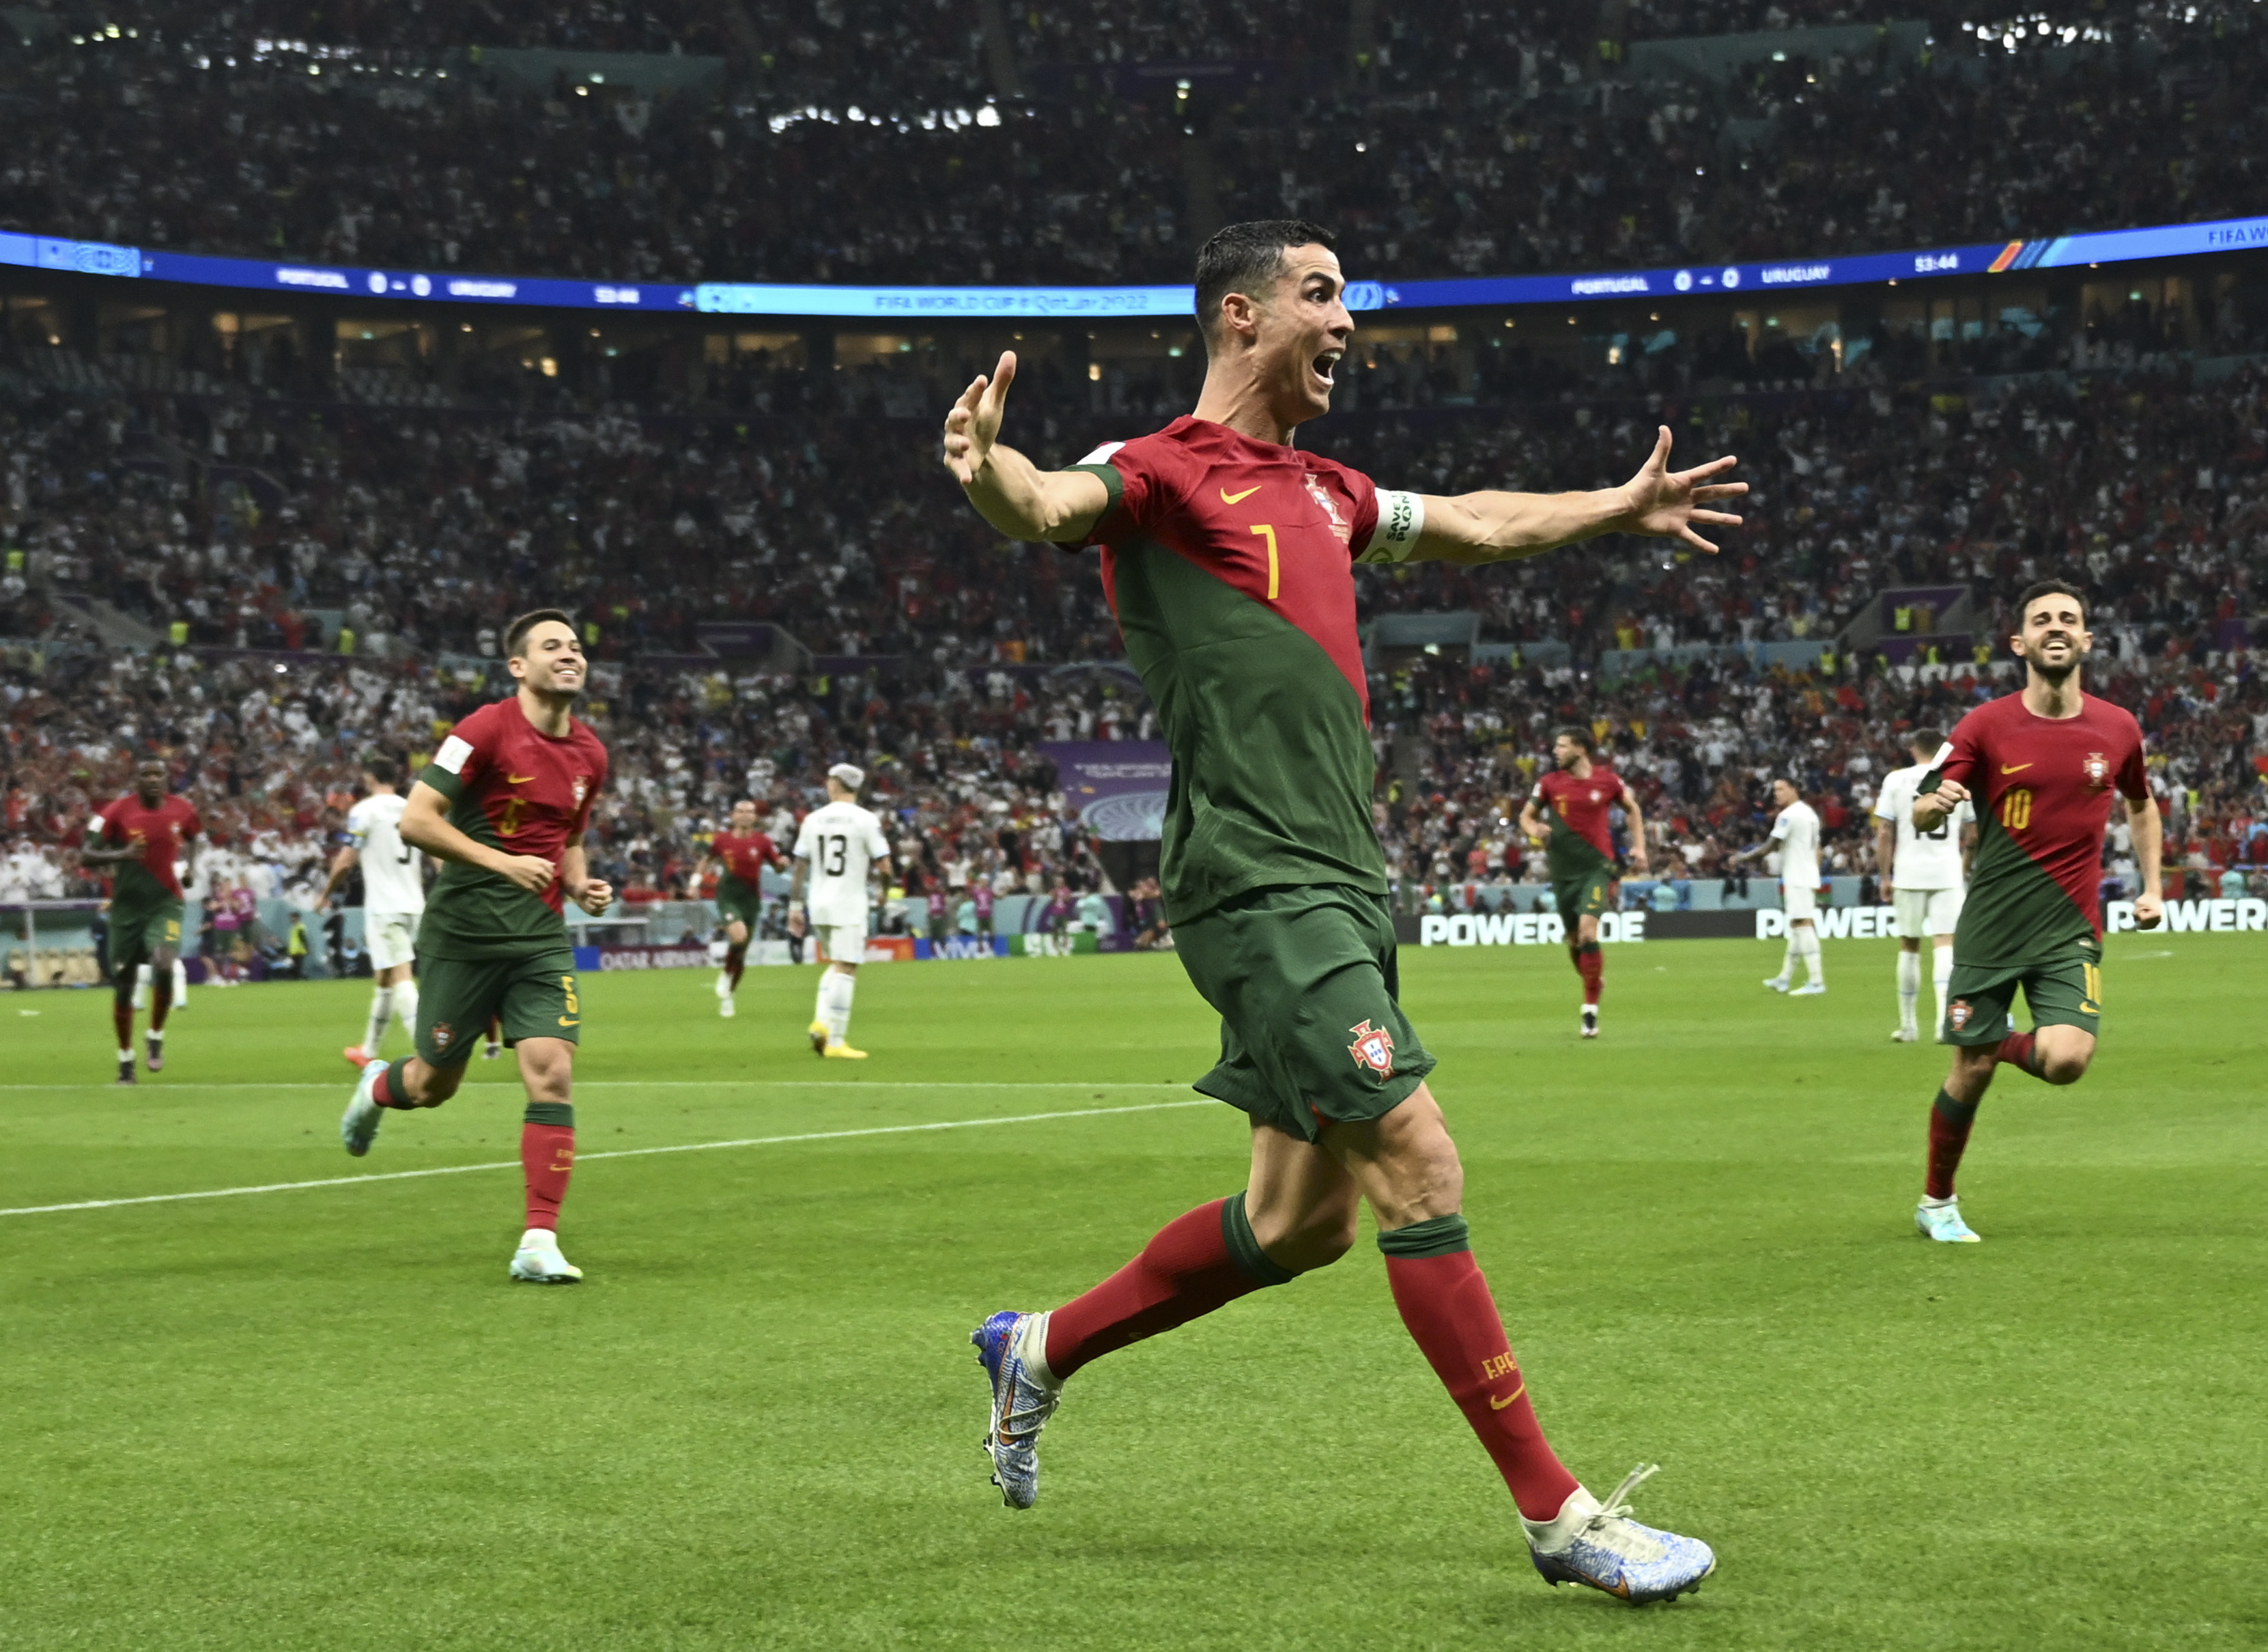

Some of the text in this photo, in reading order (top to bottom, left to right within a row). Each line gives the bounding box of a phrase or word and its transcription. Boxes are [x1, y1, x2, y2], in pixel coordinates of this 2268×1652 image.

[2208, 226, 2268, 244] FIFA W
[1572, 276, 1649, 295] PORTUGAL
[1673, 269, 1693, 292] 0
[1721, 266, 1740, 289] 0
[1761, 264, 1831, 283] URUGUAY
[1914, 255, 1958, 272] 53:44
[875, 296, 911, 309] FIFA
[916, 296, 978, 310] WORLD
[985, 296, 1015, 309] CUP
[1386, 502, 1401, 540] SAVE
[1395, 492, 1412, 542] PLAN
[1249, 524, 1279, 600] 7
[2002, 788, 2032, 830] 10
[818, 835, 847, 877] 13
[1421, 911, 1646, 947] POWERDE
[1756, 906, 1933, 940] PWER
[2107, 898, 2268, 933] PWER
